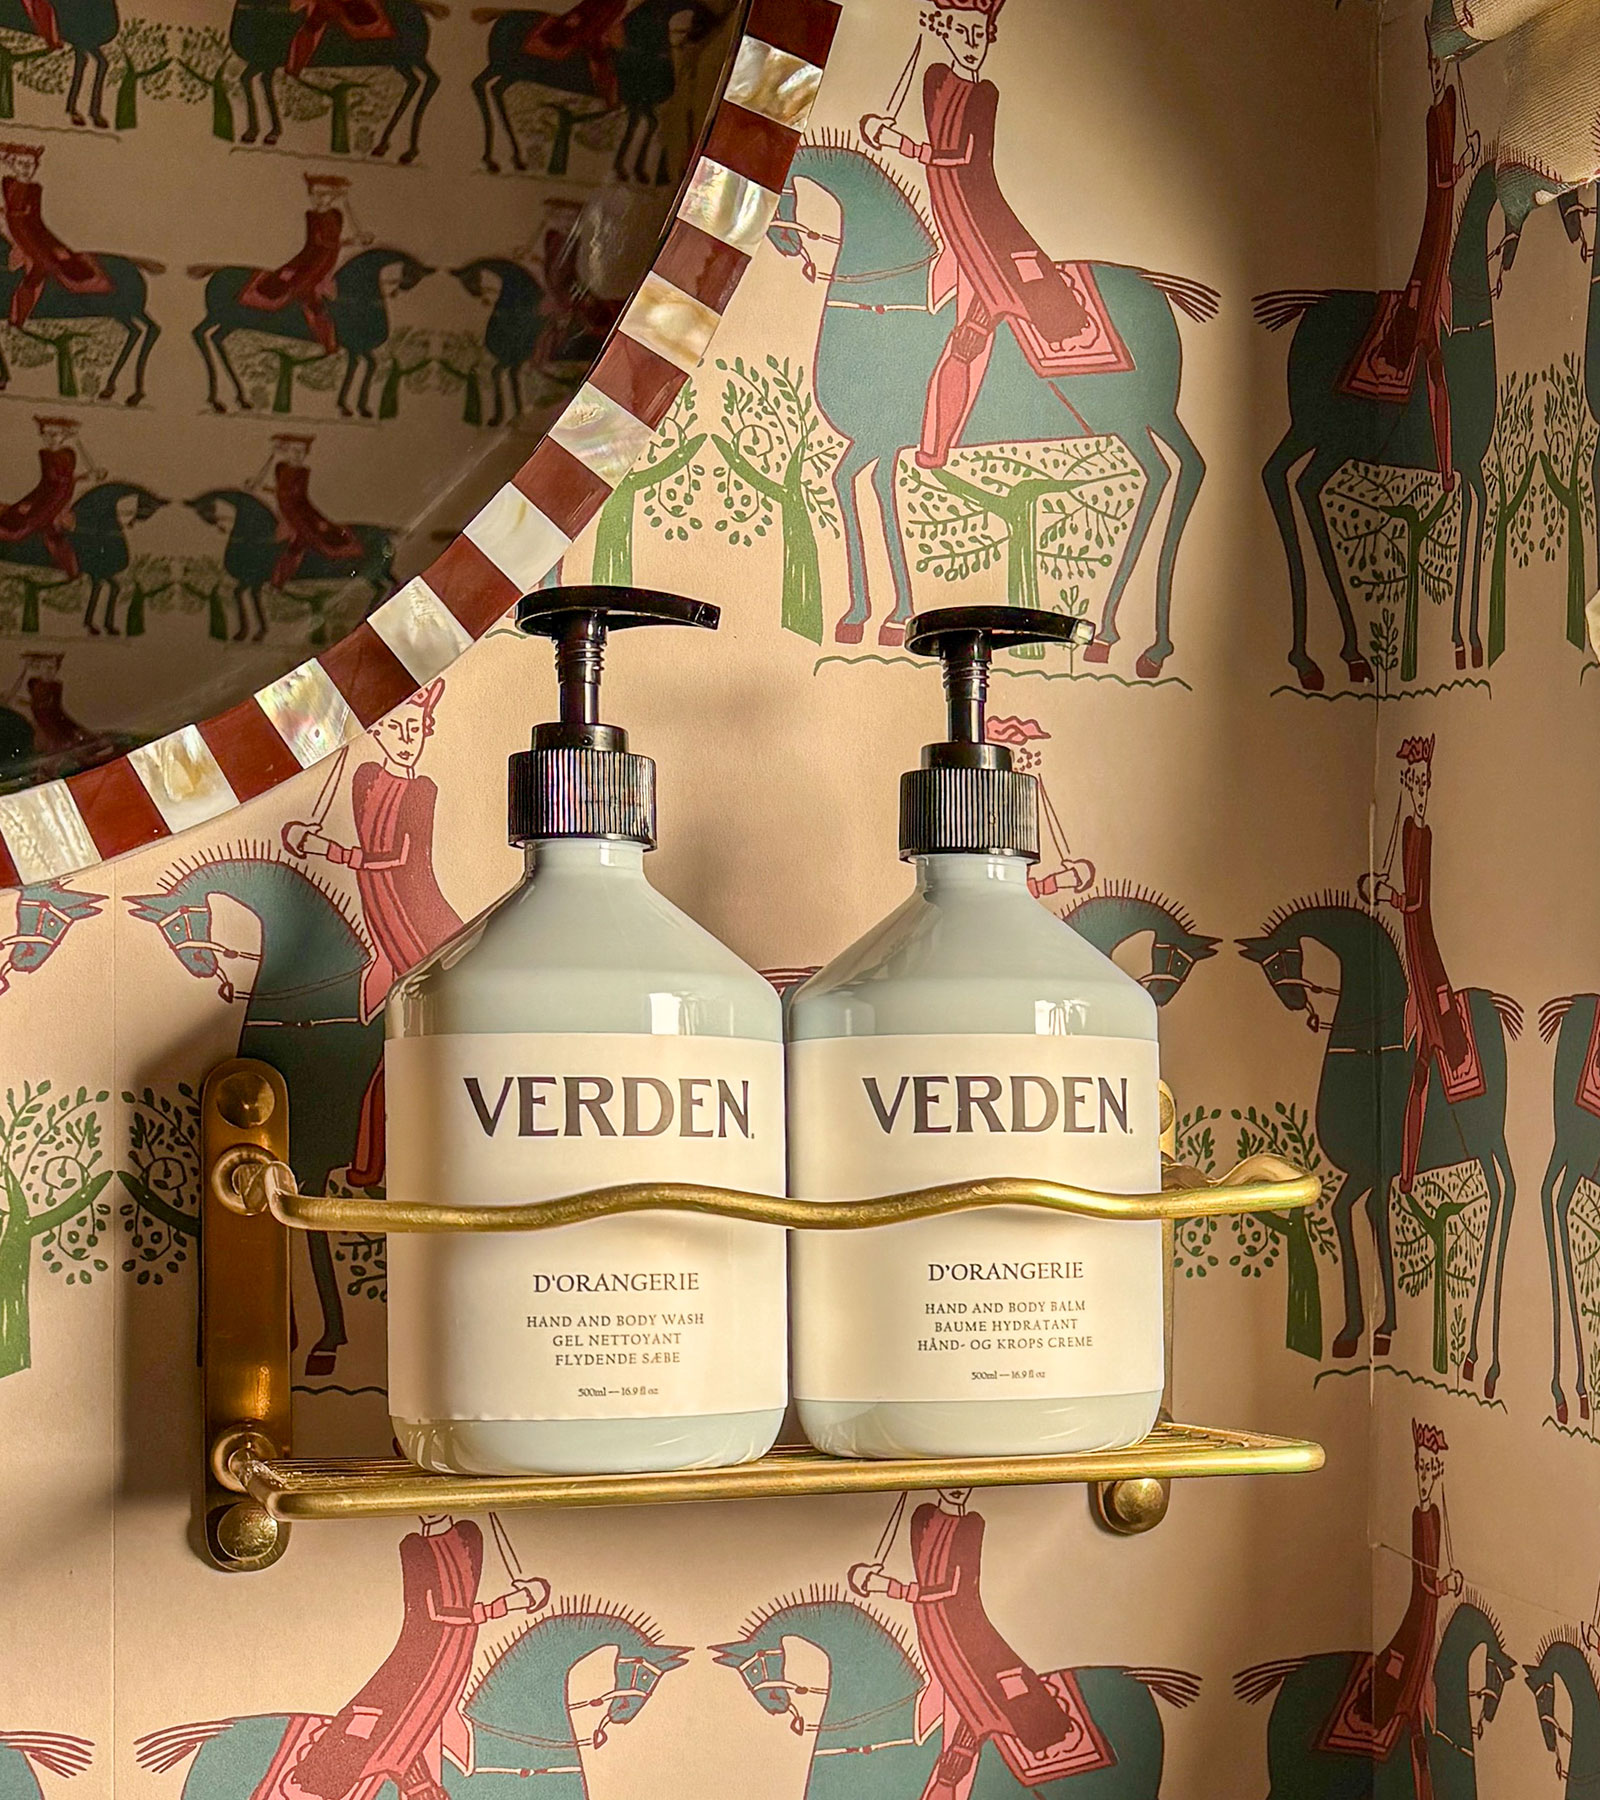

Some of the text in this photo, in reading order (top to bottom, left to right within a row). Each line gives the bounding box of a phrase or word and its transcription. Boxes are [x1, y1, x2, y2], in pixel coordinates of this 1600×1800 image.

[925, 1301, 1085, 1314] HAND AND BODY BALM
[527, 1313, 704, 1328] HAND AND BODY WASH
[935, 1319, 1078, 1333] BAUME HYDRATANT
[553, 1333, 682, 1347] GEL NETTOYANT
[918, 1336, 1093, 1351] HÅND- OG KROPS CREME
[556, 1352, 680, 1366] FLYDENDE SÆBE
[971, 1370, 997, 1380] 500ml
[1011, 1370, 1027, 1379] 16.9
[578, 1387, 606, 1398] 500ml
[621, 1387, 638, 1395] 16.9
